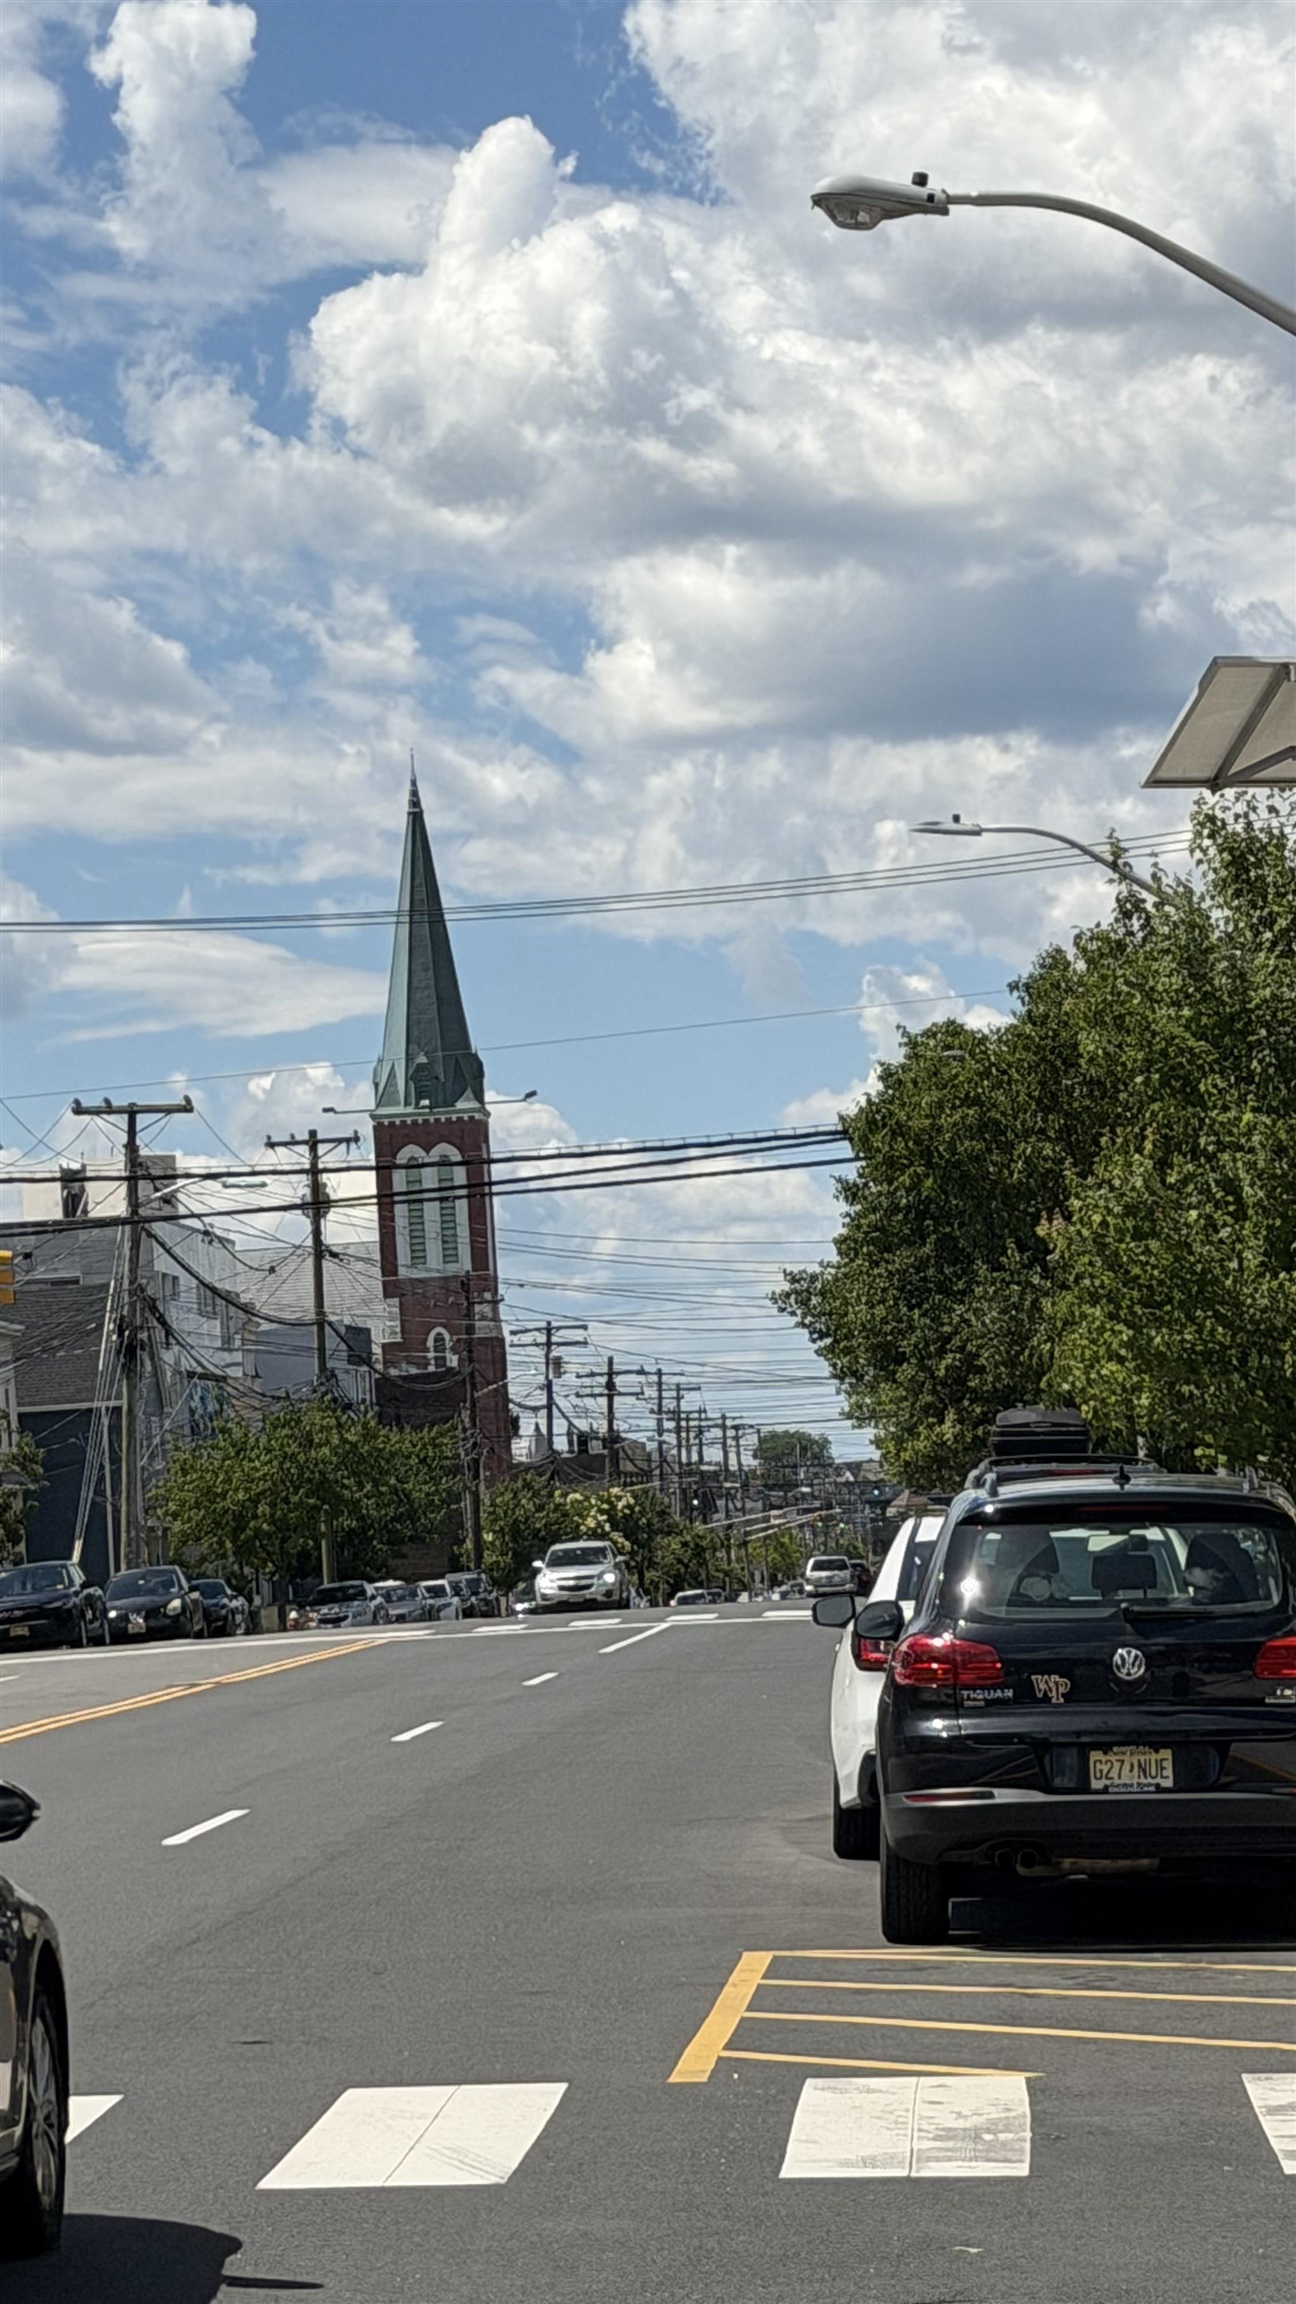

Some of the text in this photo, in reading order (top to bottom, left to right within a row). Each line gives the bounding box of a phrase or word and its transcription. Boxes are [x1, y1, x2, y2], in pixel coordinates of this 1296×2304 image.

[1113, 1647, 1146, 1680] VW
[961, 1688, 1014, 1700] TIQUAN
[1031, 1674, 1071, 1704] WP
